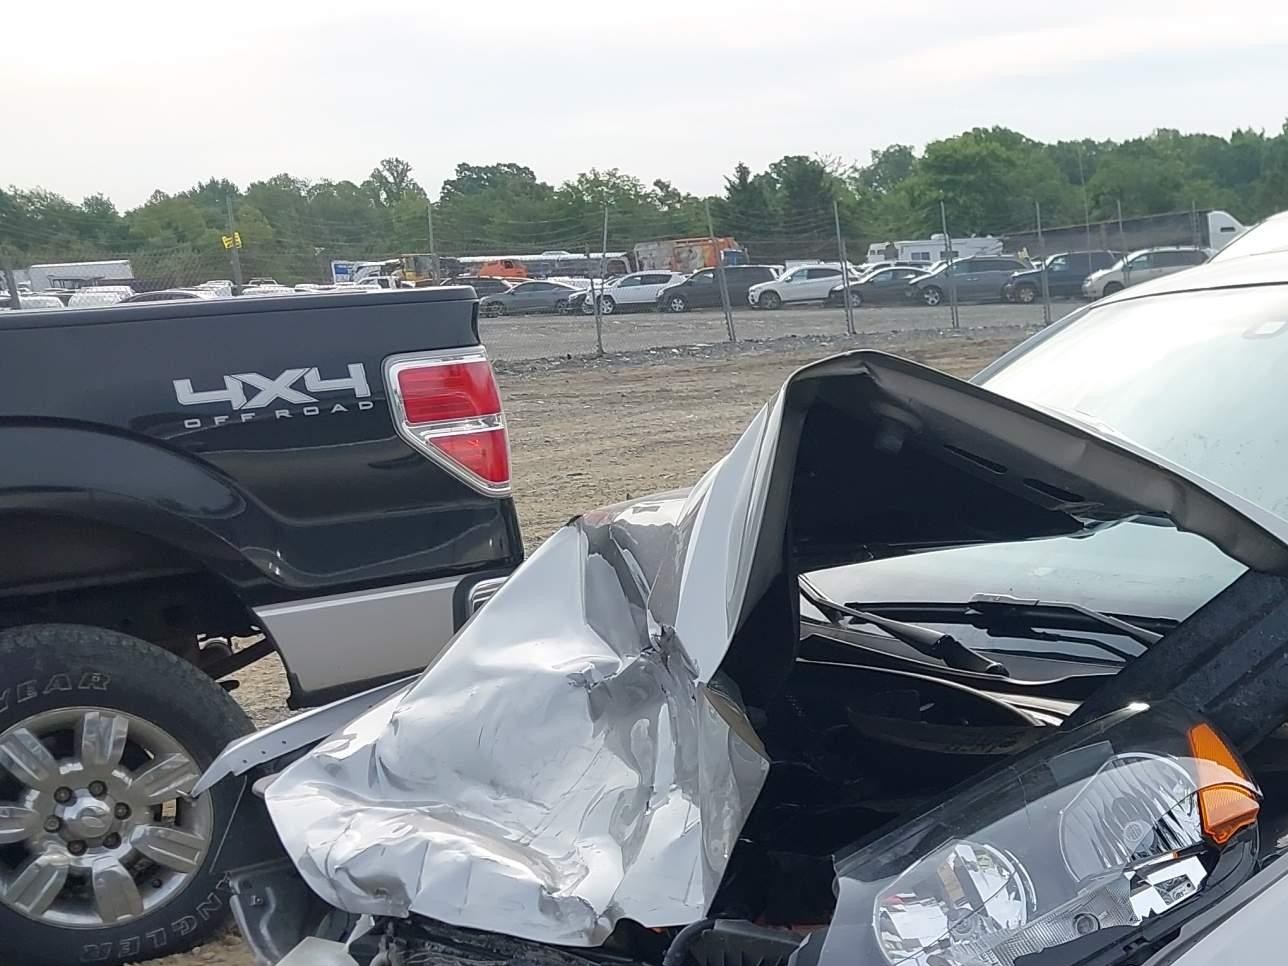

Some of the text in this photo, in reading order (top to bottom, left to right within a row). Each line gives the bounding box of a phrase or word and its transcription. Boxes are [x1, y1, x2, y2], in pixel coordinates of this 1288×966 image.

[173, 363, 371, 410] 4X4
[184, 401, 374, 428] OFF ROAD
